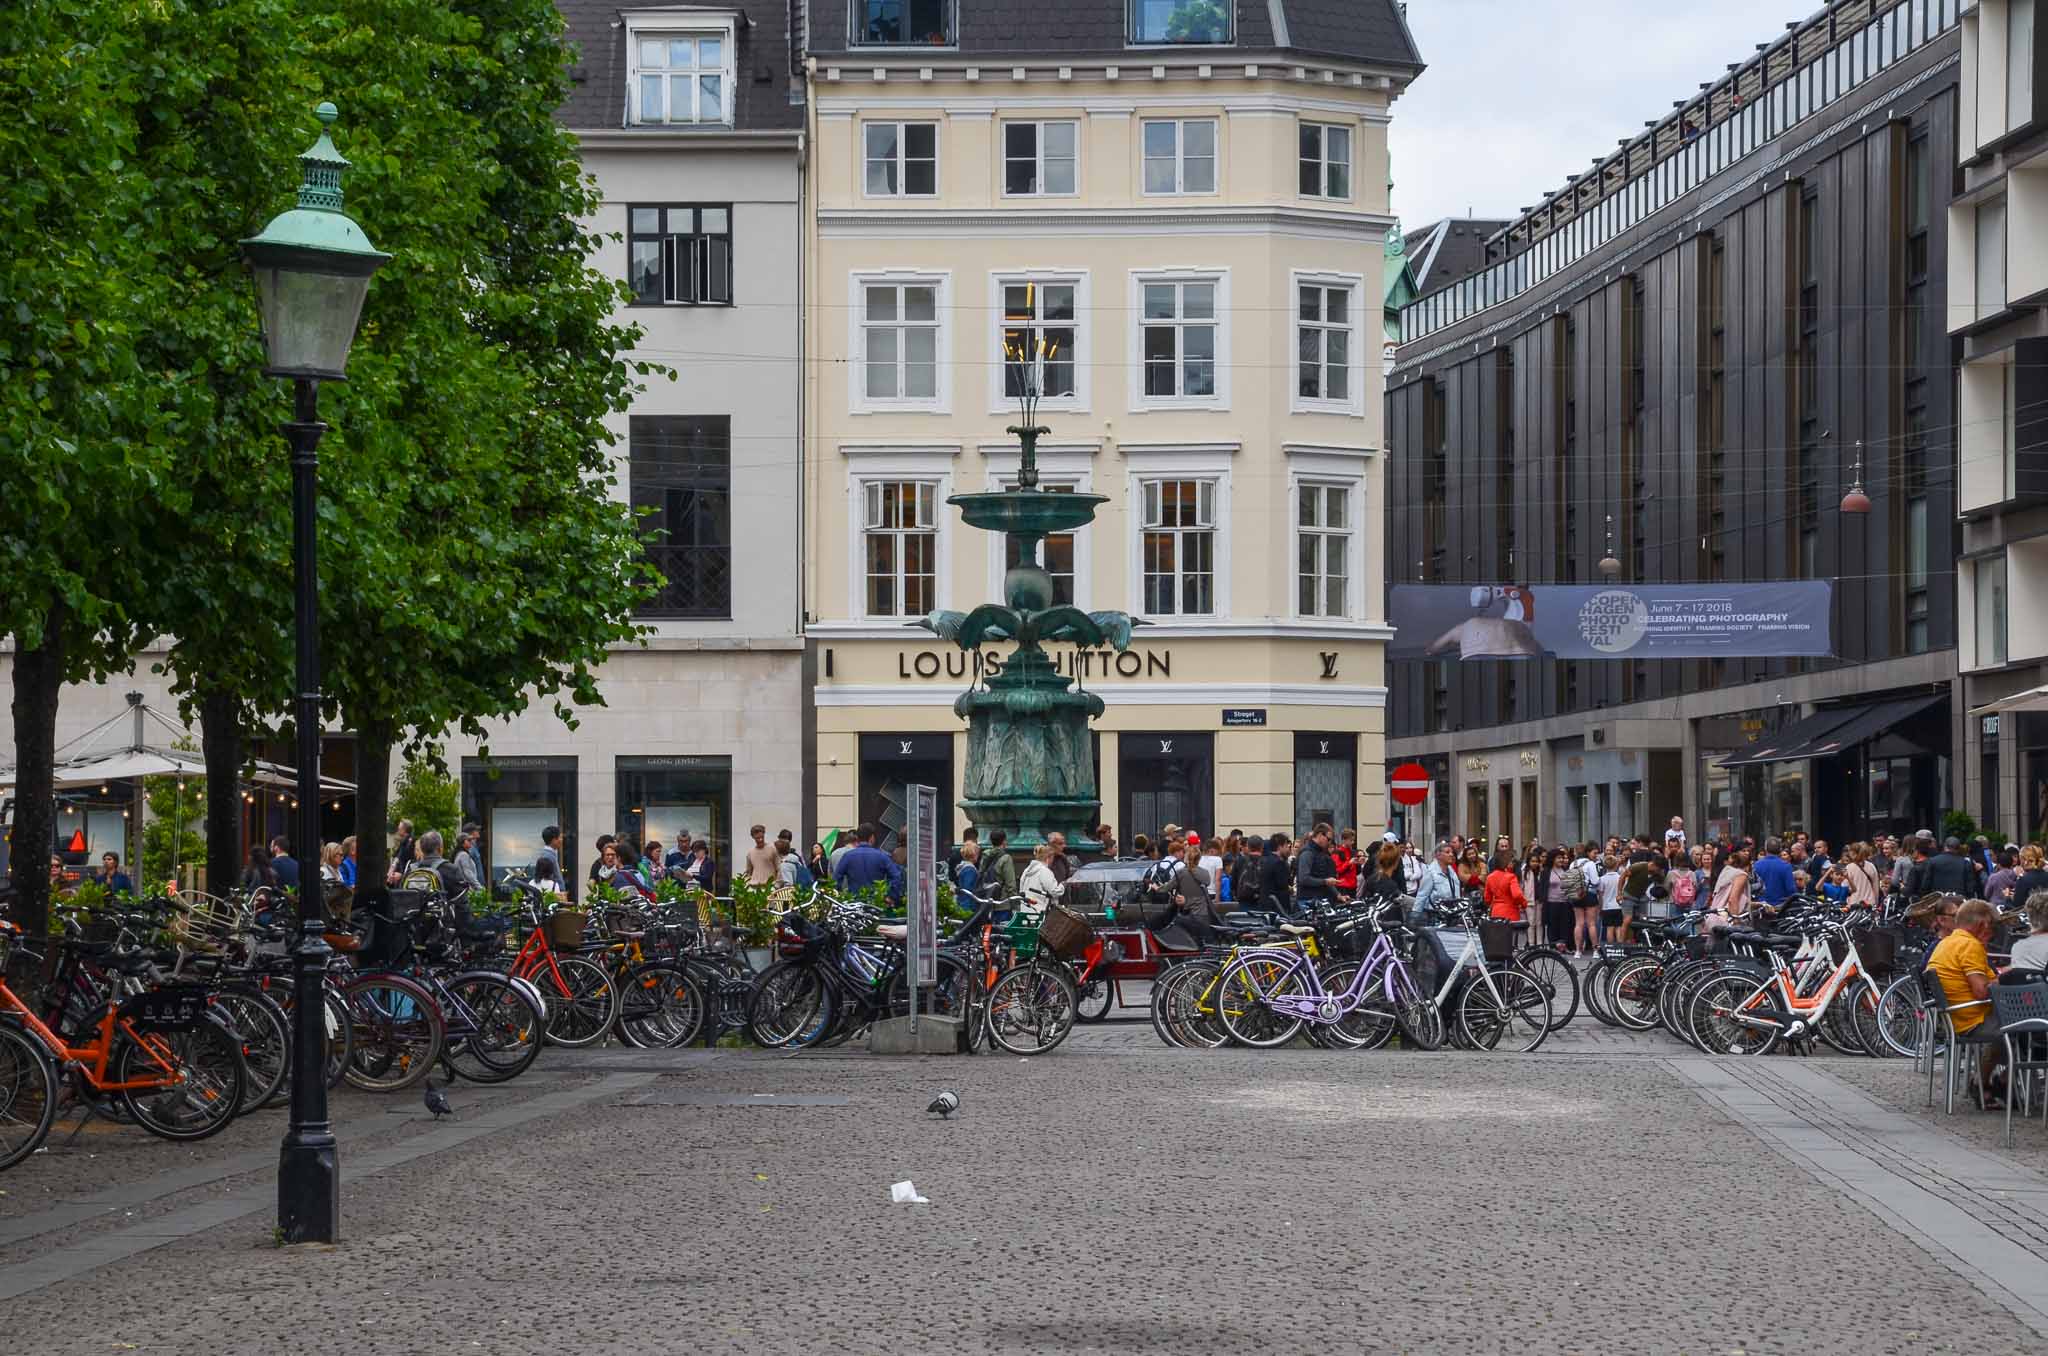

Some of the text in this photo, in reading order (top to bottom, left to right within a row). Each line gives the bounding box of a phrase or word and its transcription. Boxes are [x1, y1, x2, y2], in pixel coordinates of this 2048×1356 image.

[1581, 604, 1634, 615] HAGEN
[1650, 603, 1673, 613] June
[1675, 603, 1683, 612] 7
[1692, 603, 1704, 612] 17
[1706, 602, 1733, 612] 2018
[1577, 614, 1630, 625] PHOTO
[1638, 613, 1789, 623] CELEBRATING PHOTOGRAPHY
[1580, 625, 1621, 635] FESTI
[1583, 635, 1613, 646] VAL
[899, 651, 1001, 678] LOUIS
